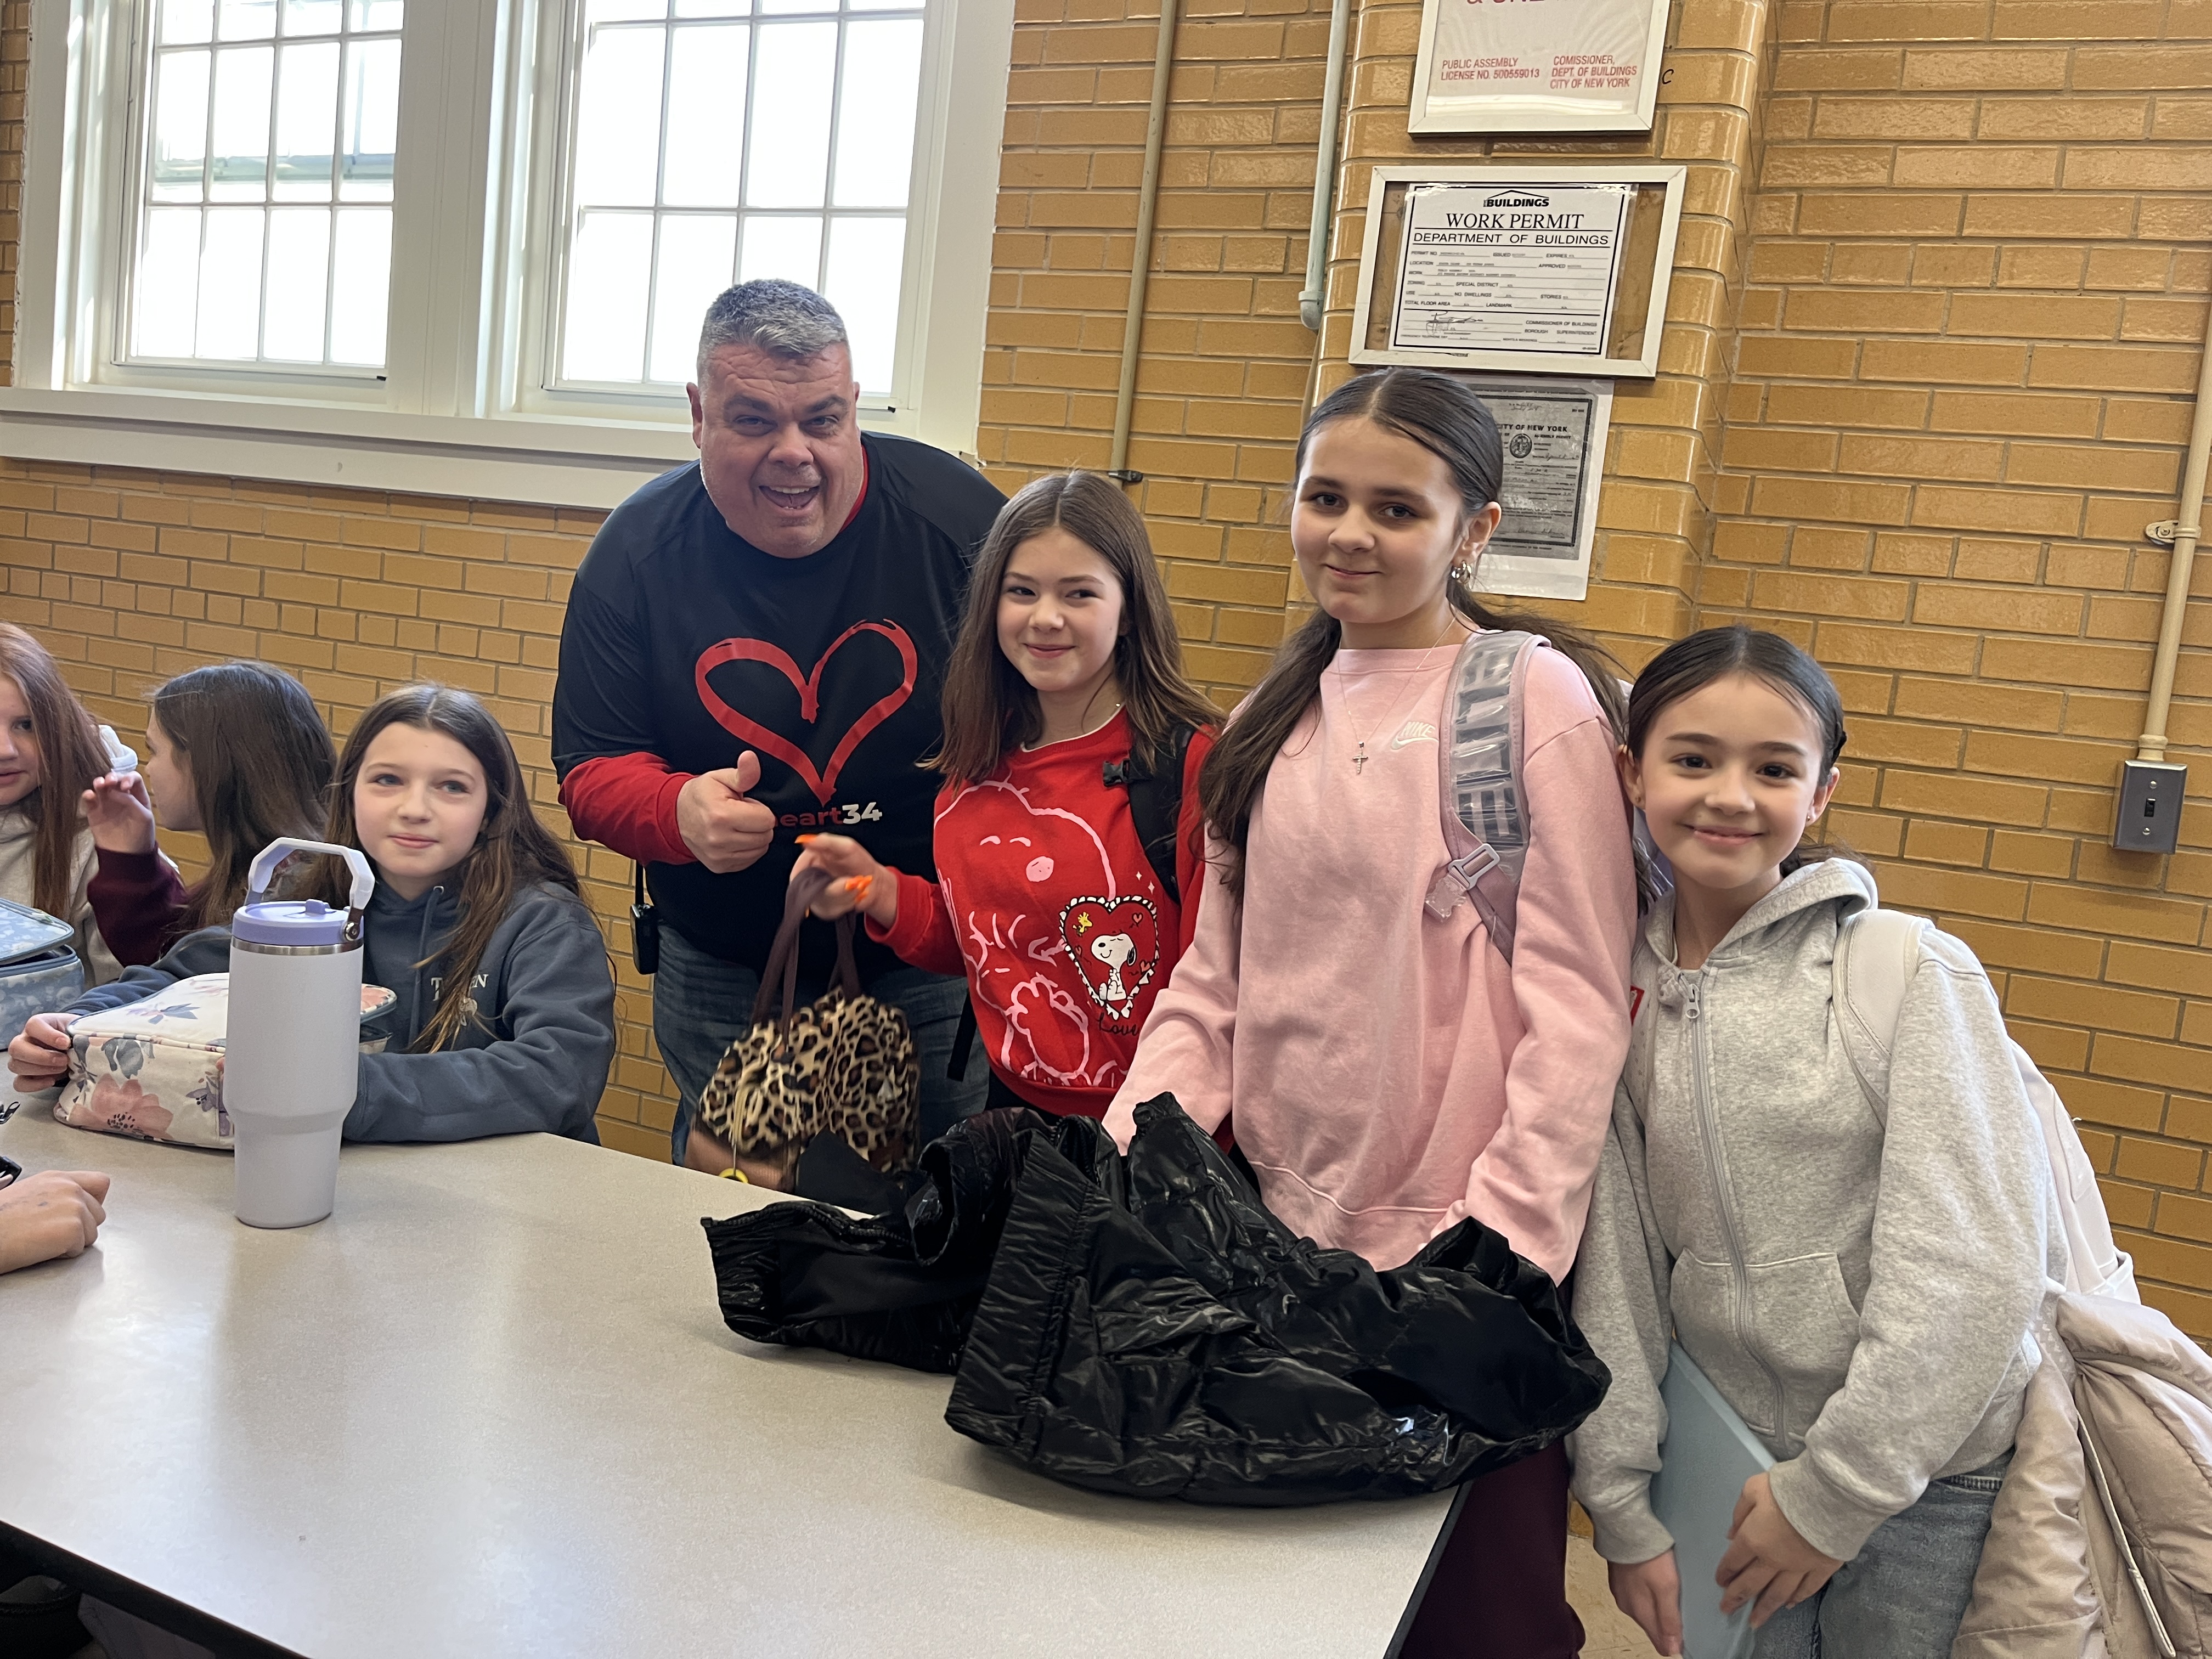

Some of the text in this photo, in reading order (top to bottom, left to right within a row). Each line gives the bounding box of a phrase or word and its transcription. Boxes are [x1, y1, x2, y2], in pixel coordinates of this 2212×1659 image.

[1442, 57, 1519, 69] PUBLIC ASSEMBLY
[1553, 55, 1615, 66] COMISSIONER,
[1441, 69, 1540, 80] LICENSE NO. 500559013
[1551, 66, 1637, 77] DEPT. OF BUILDINGS
[1550, 77, 1630, 89] CITY OF NEW YORK
[1486, 198, 1550, 207] BUILDINGS
[1446, 213, 1584, 229] WORK PERMIT
[1413, 233, 1609, 245] DEPARTMENT OF BUILDINGS
[1401, 721, 1436, 737] NIKE
[774, 802, 883, 827] eart34
[1096, 1012, 1140, 1036] Love
